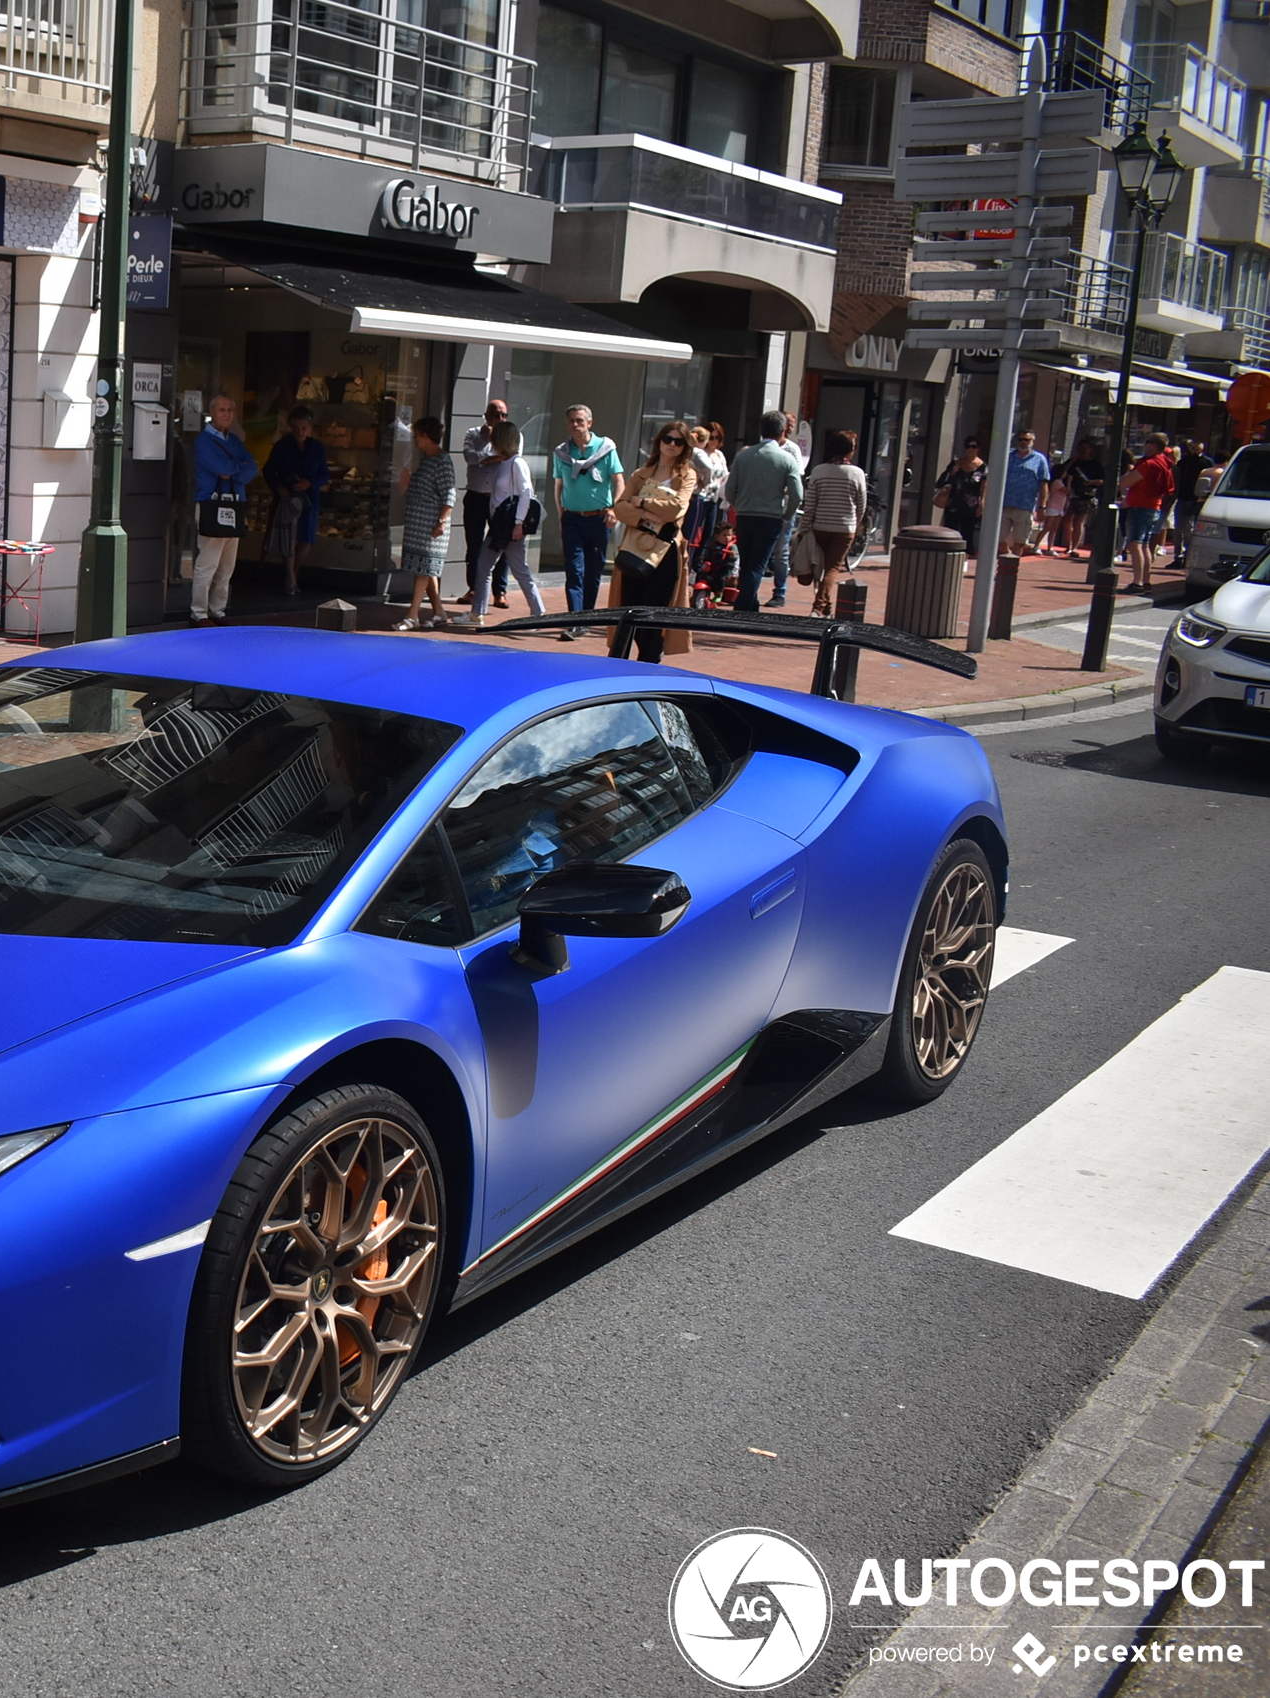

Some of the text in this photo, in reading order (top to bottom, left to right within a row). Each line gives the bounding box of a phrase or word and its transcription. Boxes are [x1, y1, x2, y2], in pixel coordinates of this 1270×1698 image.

[181, 182, 255, 211] Gabor
[382, 178, 479, 239] Gabor
[127, 254, 165, 274] Perle
[132, 274, 154, 283] DIEUX
[341, 341, 380, 355] Gabor
[846, 334, 905, 371] ONLY
[963, 349, 1005, 357] ONLY
[135, 381, 158, 392] ORCA
